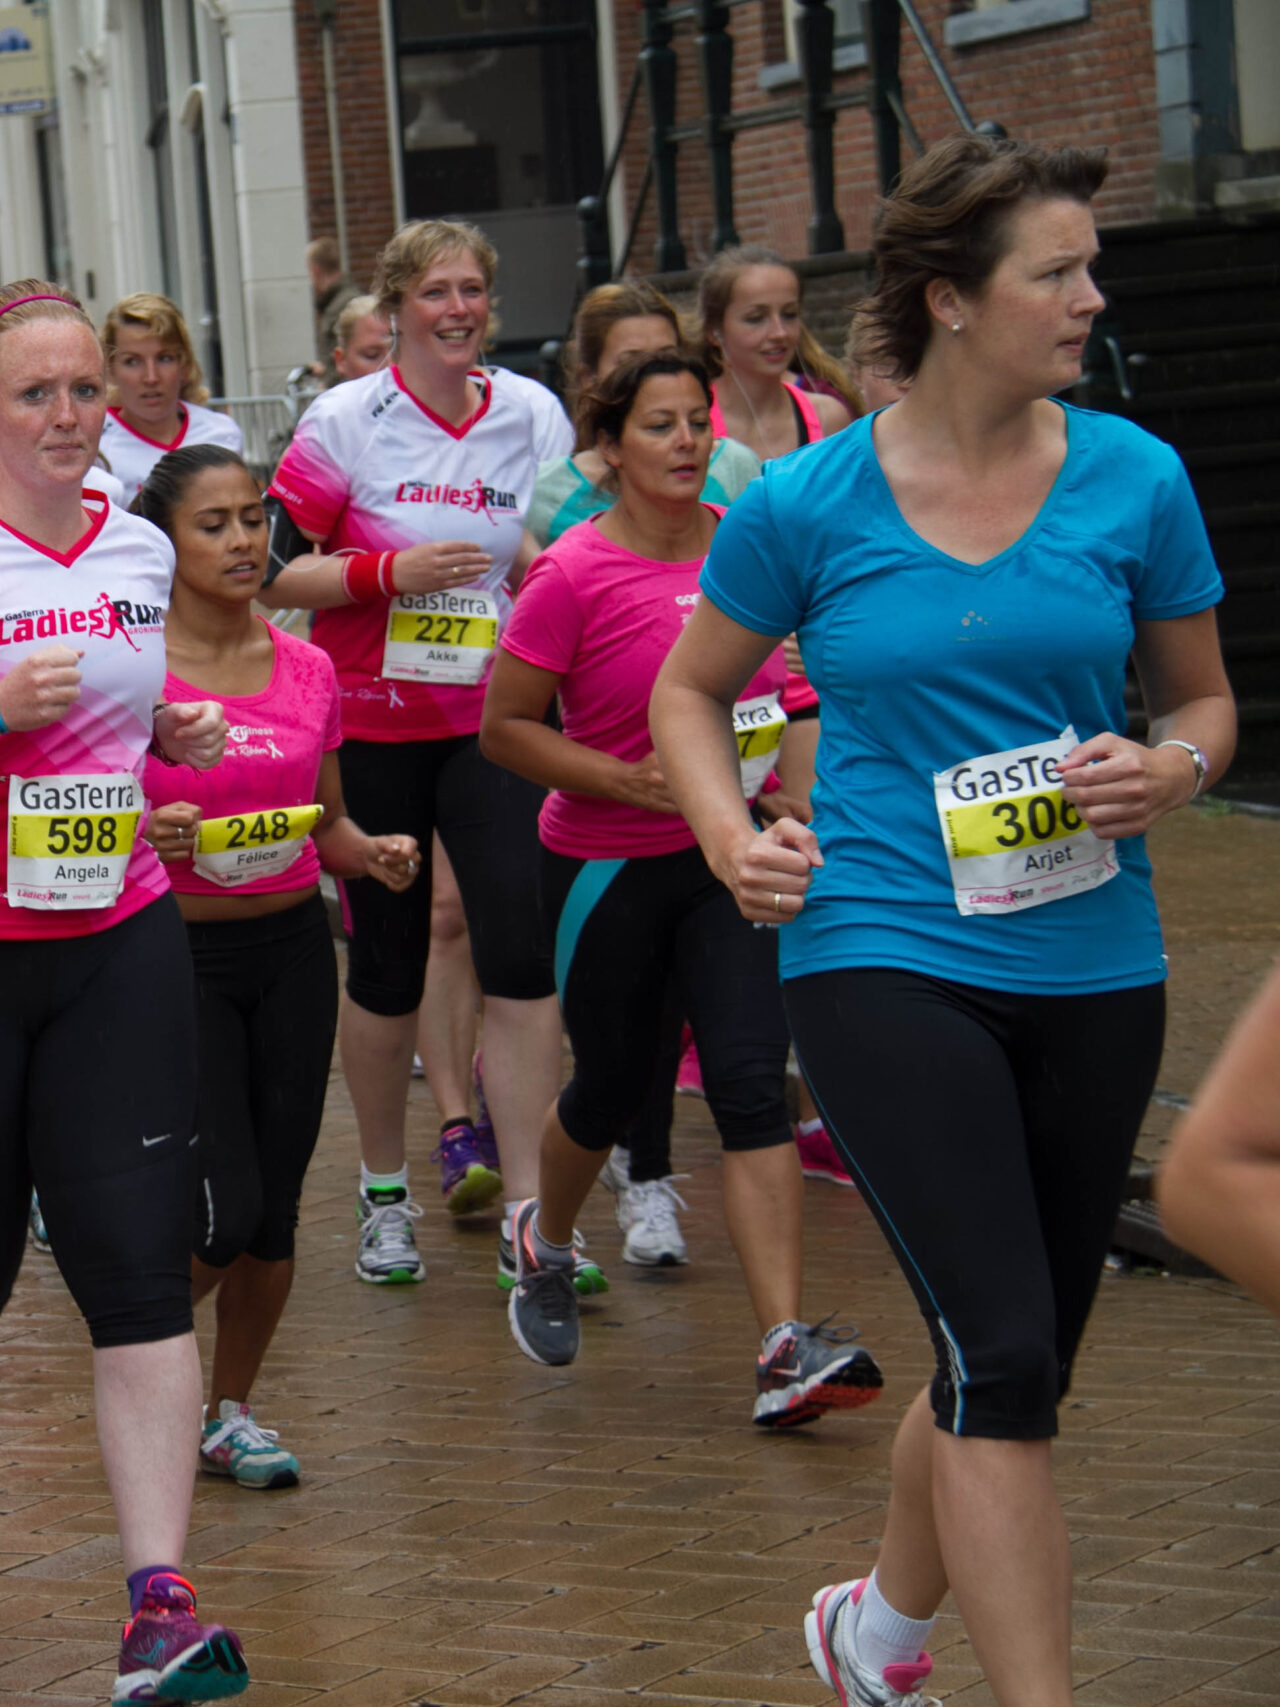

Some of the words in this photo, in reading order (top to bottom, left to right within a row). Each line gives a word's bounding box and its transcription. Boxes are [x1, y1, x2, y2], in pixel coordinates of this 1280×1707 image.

[482, 487, 517, 509] Run
[5, 608, 45, 622] GasTerra
[112, 600, 162, 626] Run
[399, 592, 488, 615] GasTerra
[415, 616, 471, 645] 227
[426, 649, 459, 662] Akke
[950, 755, 1070, 801] GasTe
[20, 781, 134, 810] GasTerra
[226, 811, 289, 848] 248
[992, 796, 1082, 847] 306
[47, 816, 117, 854] 598
[237, 849, 279, 866] Félice
[1024, 846, 1073, 872] Arjet
[55, 863, 109, 883] Angela
